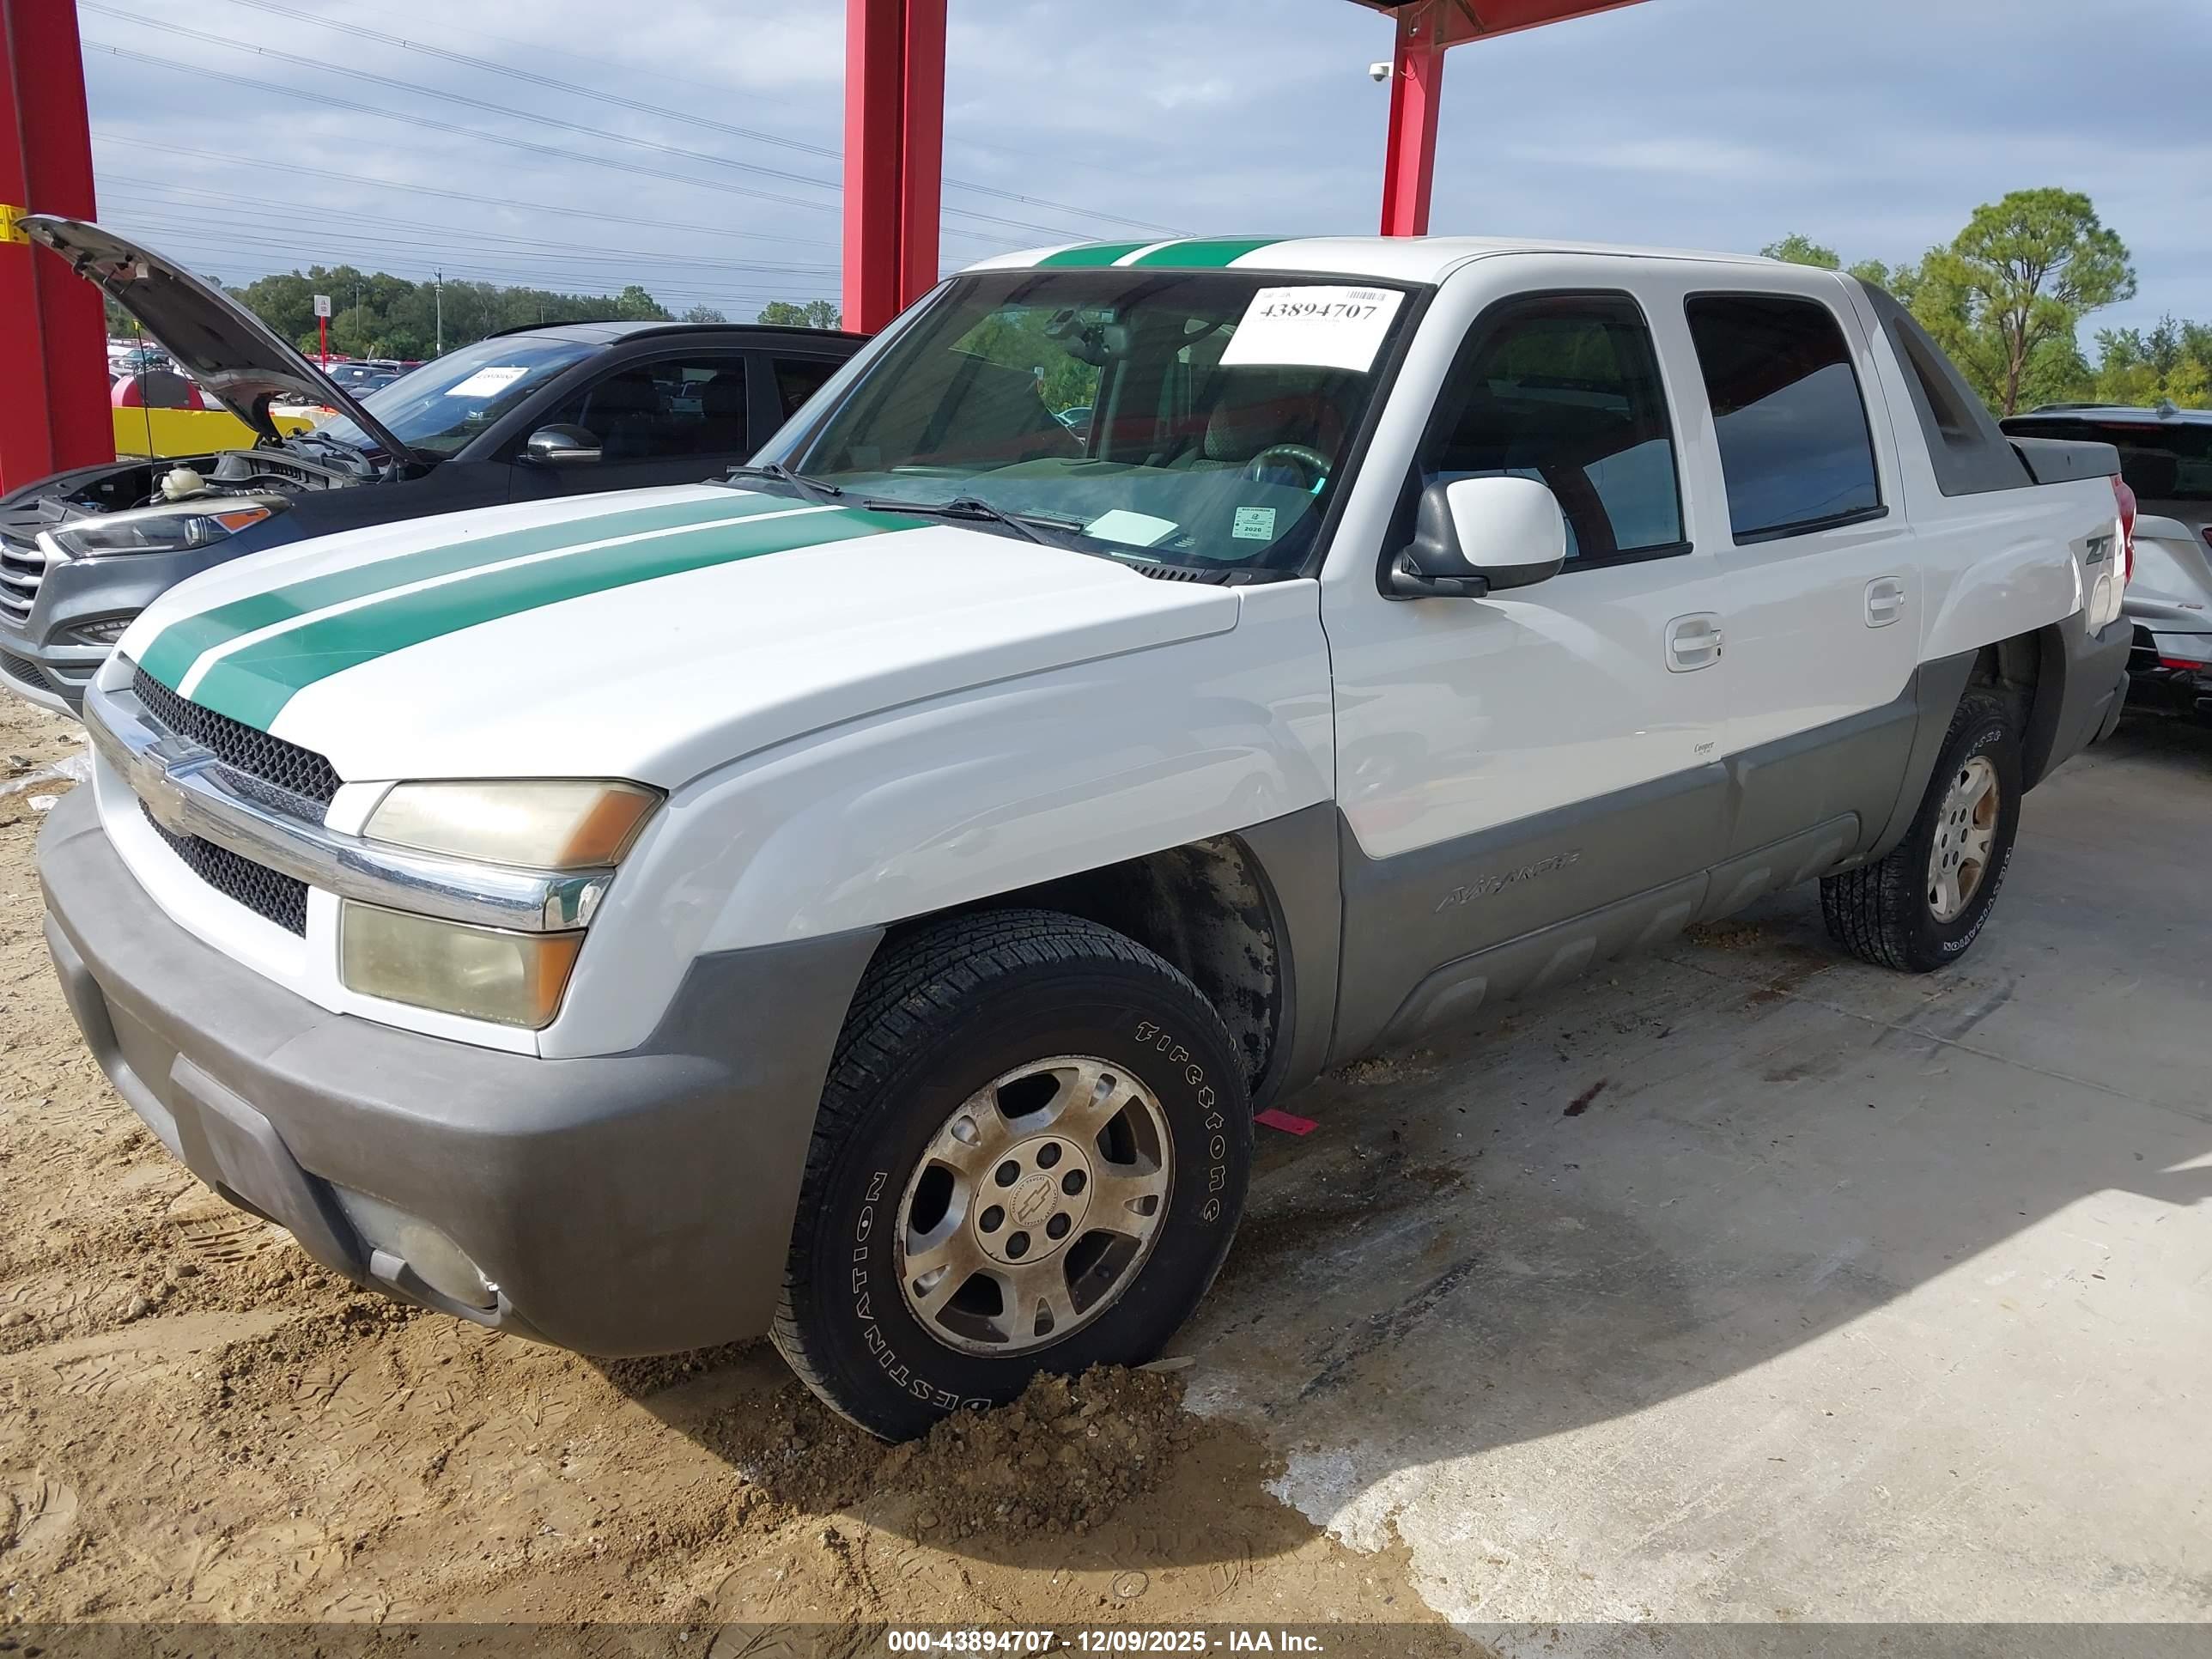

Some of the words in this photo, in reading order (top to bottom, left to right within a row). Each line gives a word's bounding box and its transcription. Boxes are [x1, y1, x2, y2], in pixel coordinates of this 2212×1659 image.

[1260, 302, 1378, 320] 43894707
[1943, 847, 2013, 951] DESTINATION
[1134, 1020, 1226, 1223] Firestone
[852, 1171, 993, 1411] DESTINATION
